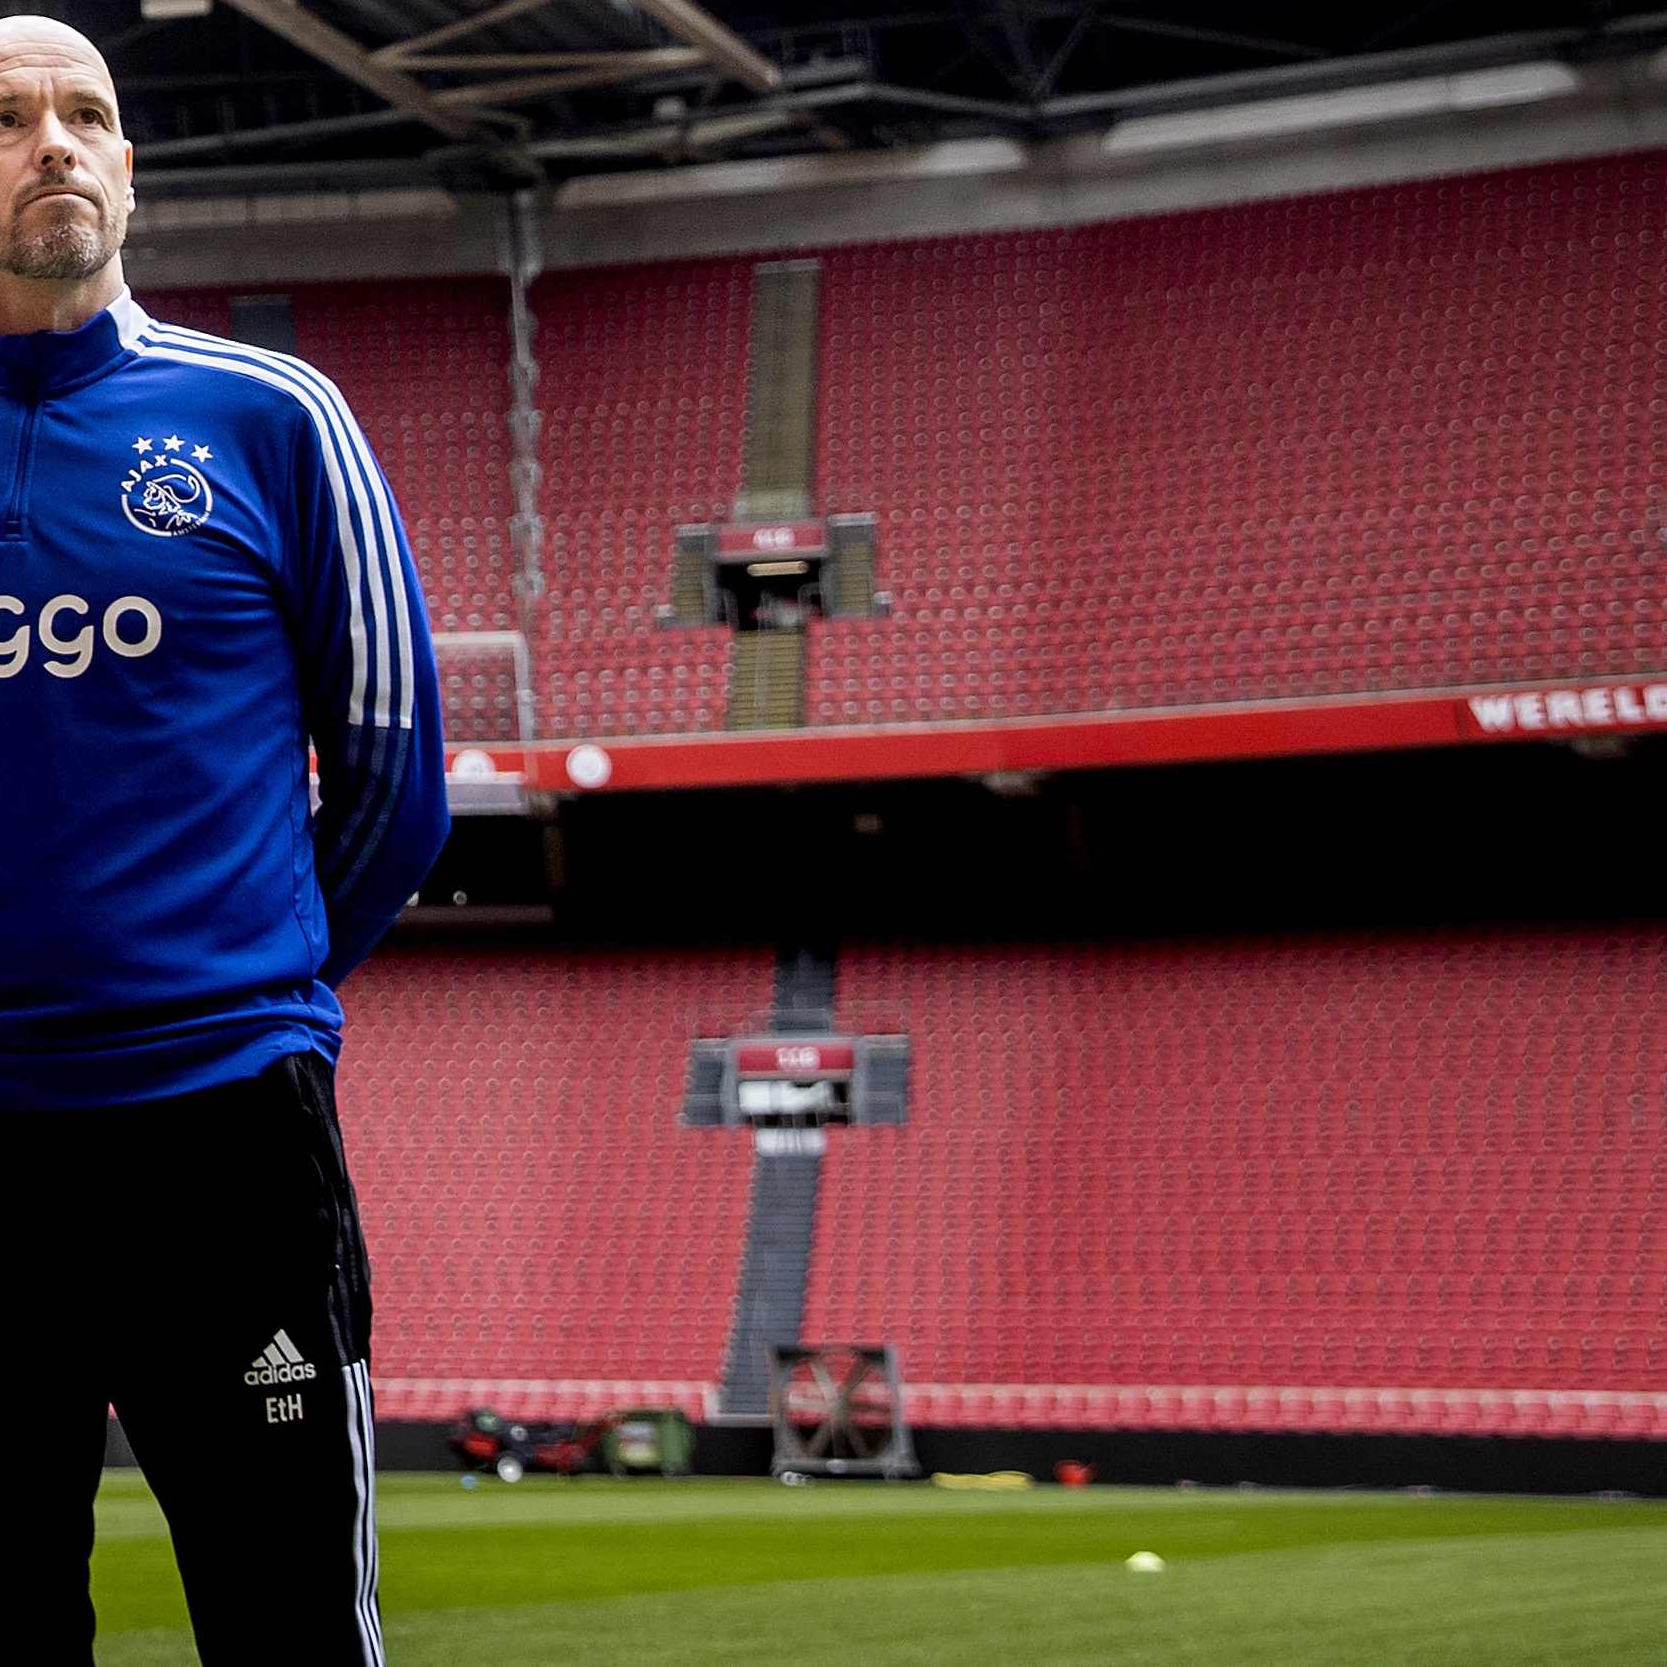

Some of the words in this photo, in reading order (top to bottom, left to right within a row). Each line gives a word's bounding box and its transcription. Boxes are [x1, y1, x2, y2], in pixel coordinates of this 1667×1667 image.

[120, 454, 169, 492] AJAX
[244, 1362, 317, 1386] adidas
[266, 1393, 304, 1424] EtH
